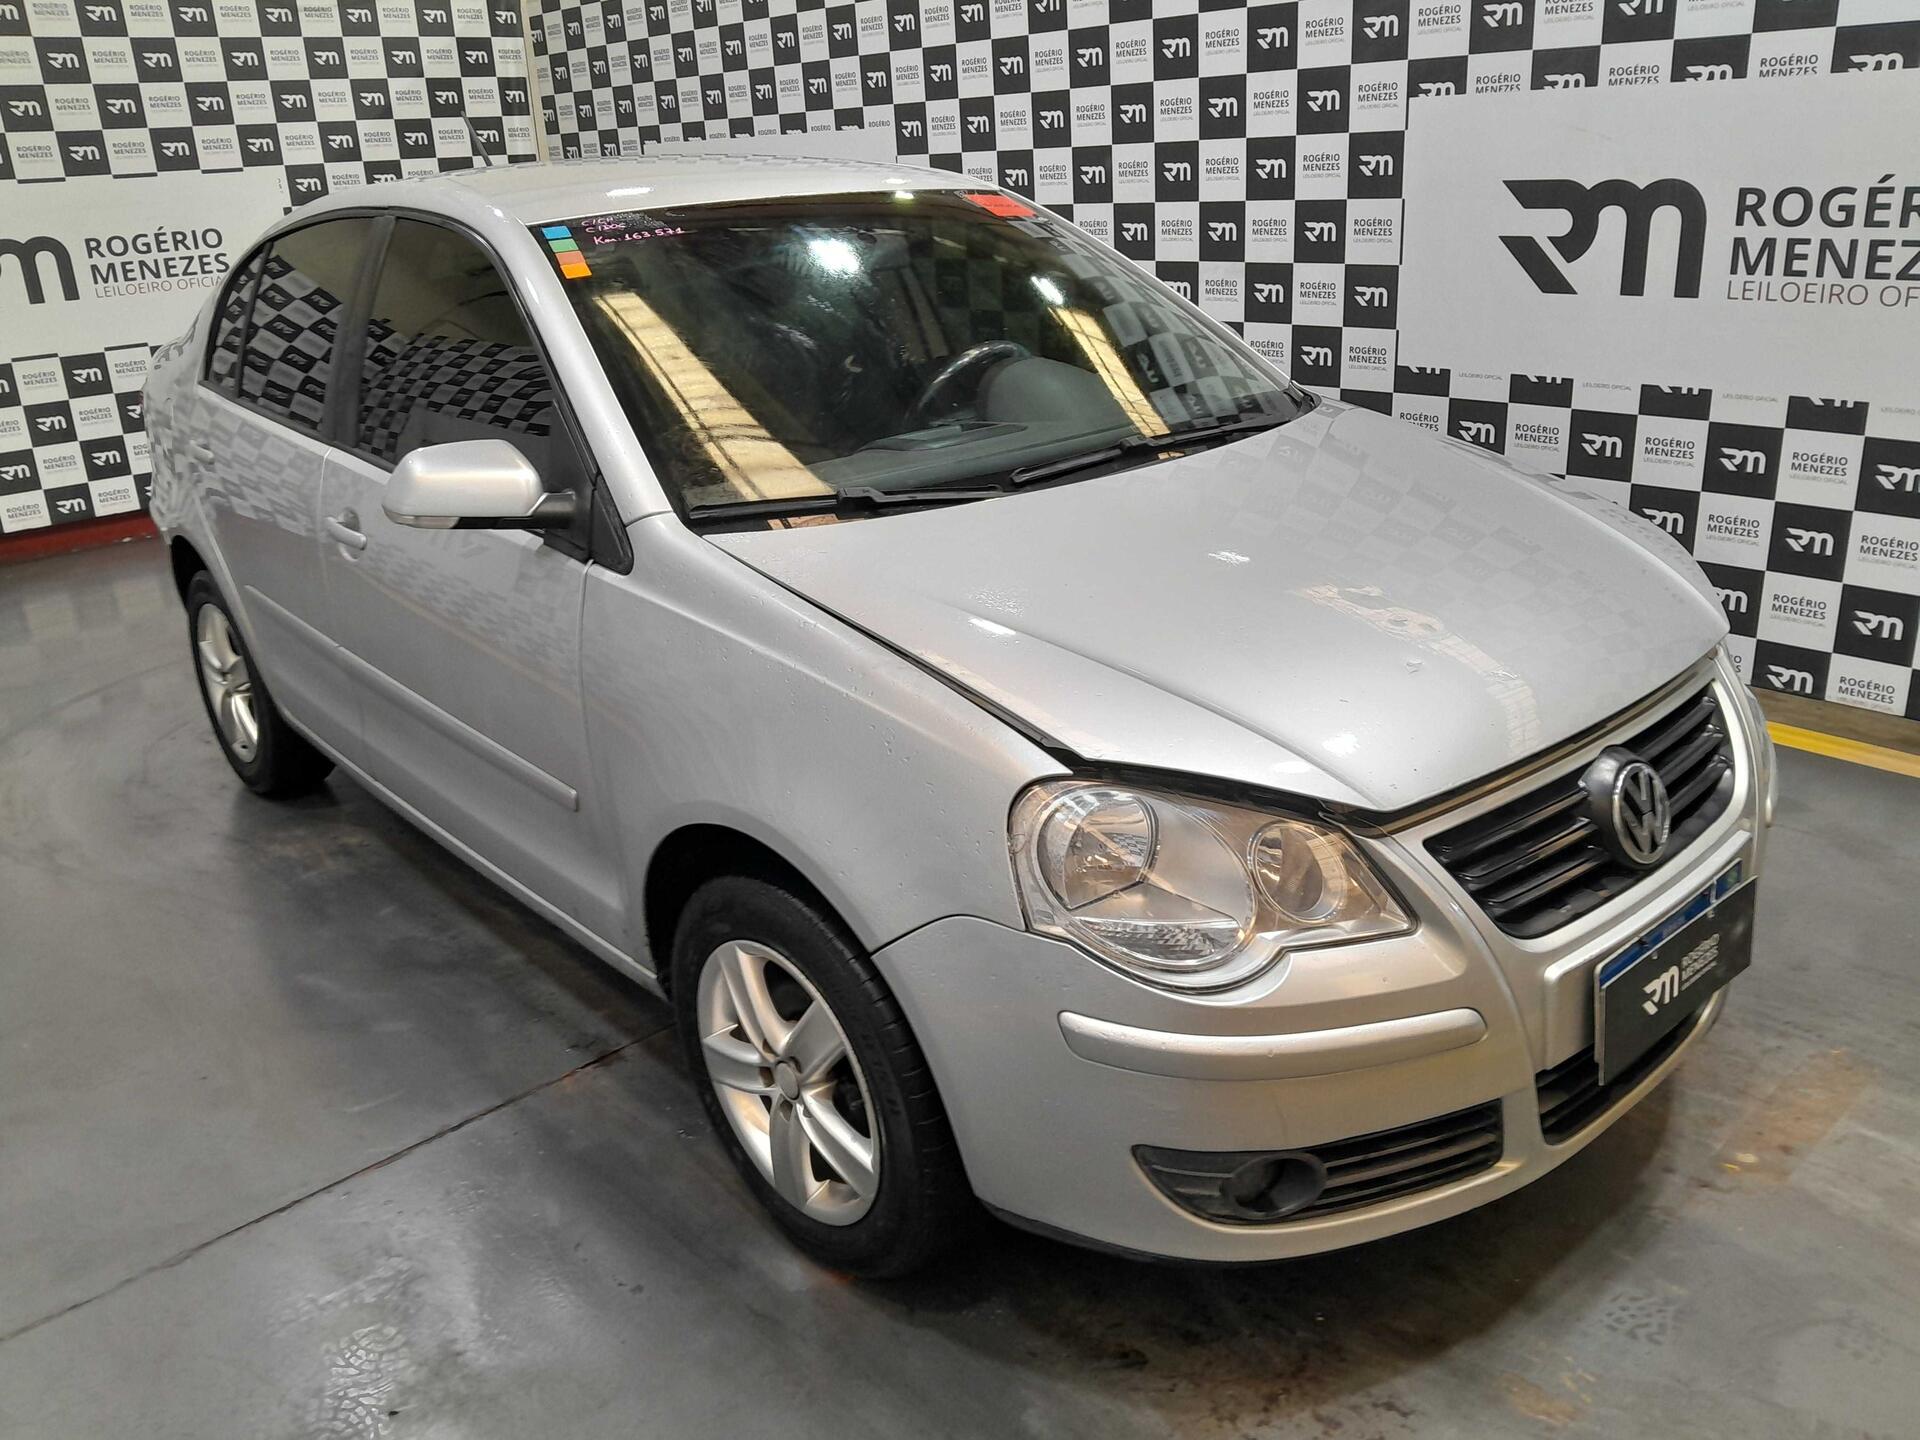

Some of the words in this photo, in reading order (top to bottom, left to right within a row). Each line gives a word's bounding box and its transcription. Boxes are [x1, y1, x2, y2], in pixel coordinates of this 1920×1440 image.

[994, 2, 1023, 14] MENEZES
[1418, 4, 1462, 18] ROGÉRIO
[1544, 1, 1596, 16] MENEZES
[1305, 16, 1344, 30] ROGÉRIO
[1417, 14, 1462, 28] MENEZES
[1205, 28, 1240, 40] ROGÉRIO
[1305, 26, 1345, 39] MENEZES
[1115, 38, 1147, 50] ROGÉRIO
[1205, 37, 1240, 49] MENEZES
[1034, 48, 1063, 59] ROGÉRIO
[1115, 47, 1147, 59] MENEZES
[961, 56, 987, 67] ROGÉRIO
[1034, 56, 1064, 67] MENEZES
[1759, 53, 1819, 68] ROGÉRIO
[961, 64, 988, 75] MENEZES
[1608, 63, 1660, 78] ROGÉRIO
[1475, 73, 1521, 86] ROGÉRIO
[1357, 81, 1399, 94] ROGÉRIO
[1253, 89, 1290, 101] ROGÉRIO
[1357, 91, 1399, 103] MENEZES
[1160, 96, 1192, 107] ROGÉRIO
[1253, 99, 1290, 110] MENEZES
[999, 109, 1027, 119] ROGÉRIO
[1076, 103, 1105, 114] ROGÉRIO
[1159, 106, 1193, 116] MENEZES
[1000, 117, 1027, 127] MENEZES
[1076, 112, 1106, 122] MENEZES
[1205, 156, 1239, 167] ROGÉRIO
[1302, 152, 1341, 163] ROGÉRIO
[1039, 163, 1067, 173] ROGÉRIO
[1118, 159, 1149, 170] ROGÉRIO
[1205, 166, 1240, 175] MENEZES
[1302, 162, 1341, 172] MENEZES
[1039, 172, 1068, 181] MENEZES
[1118, 169, 1149, 178] MENEZES
[1079, 219, 1108, 228] ROGÉRIO
[1161, 218, 1193, 228] ROGÉRIO
[1252, 217, 1287, 228] ROGÉRIO
[1353, 217, 1393, 228] ROGÉRIO
[1161, 228, 1193, 236] MENEZES
[1251, 228, 1288, 236] MENEZES
[1353, 227, 1393, 236] MENEZES
[84, 226, 223, 259] ROGÉRIO
[90, 252, 230, 285] MENEZES
[1205, 278, 1238, 288] ROGÉRIO
[1299, 280, 1337, 291] ROGÉRIO
[94, 280, 173, 299] LEILOEIRO
[1205, 287, 1238, 296] MENEZES
[1299, 290, 1337, 300] MENEZES
[1727, 280, 1869, 306] LEILOEIRO
[1250, 339, 1285, 350] ROGÉRIO
[1348, 345, 1387, 357] ROGÉRIO
[1348, 354, 1388, 365] MENEZES
[1399, 412, 1439, 424] ROGÉRIO
[1514, 423, 1560, 436] ROGÉRIO
[1514, 432, 1560, 445] MENEZES
[1644, 436, 1696, 450] ROGÉRIO
[1643, 446, 1696, 460] MENEZES
[1791, 451, 1849, 467] ROGÉRIO
[1790, 461, 1849, 477] MENEZES
[1708, 514, 1761, 530] ROGÉRIO
[1707, 524, 1761, 540] MENEZES
[1860, 534, 1920, 552] ROGÉRIO
[1858, 544, 1920, 562] MENEZES
[1772, 593, 1827, 611] ROGÉRIO
[1770, 603, 1827, 621] MENEZES
[1838, 675, 1896, 695] ROGÉRIO
[1837, 685, 1896, 705] MENEZES
